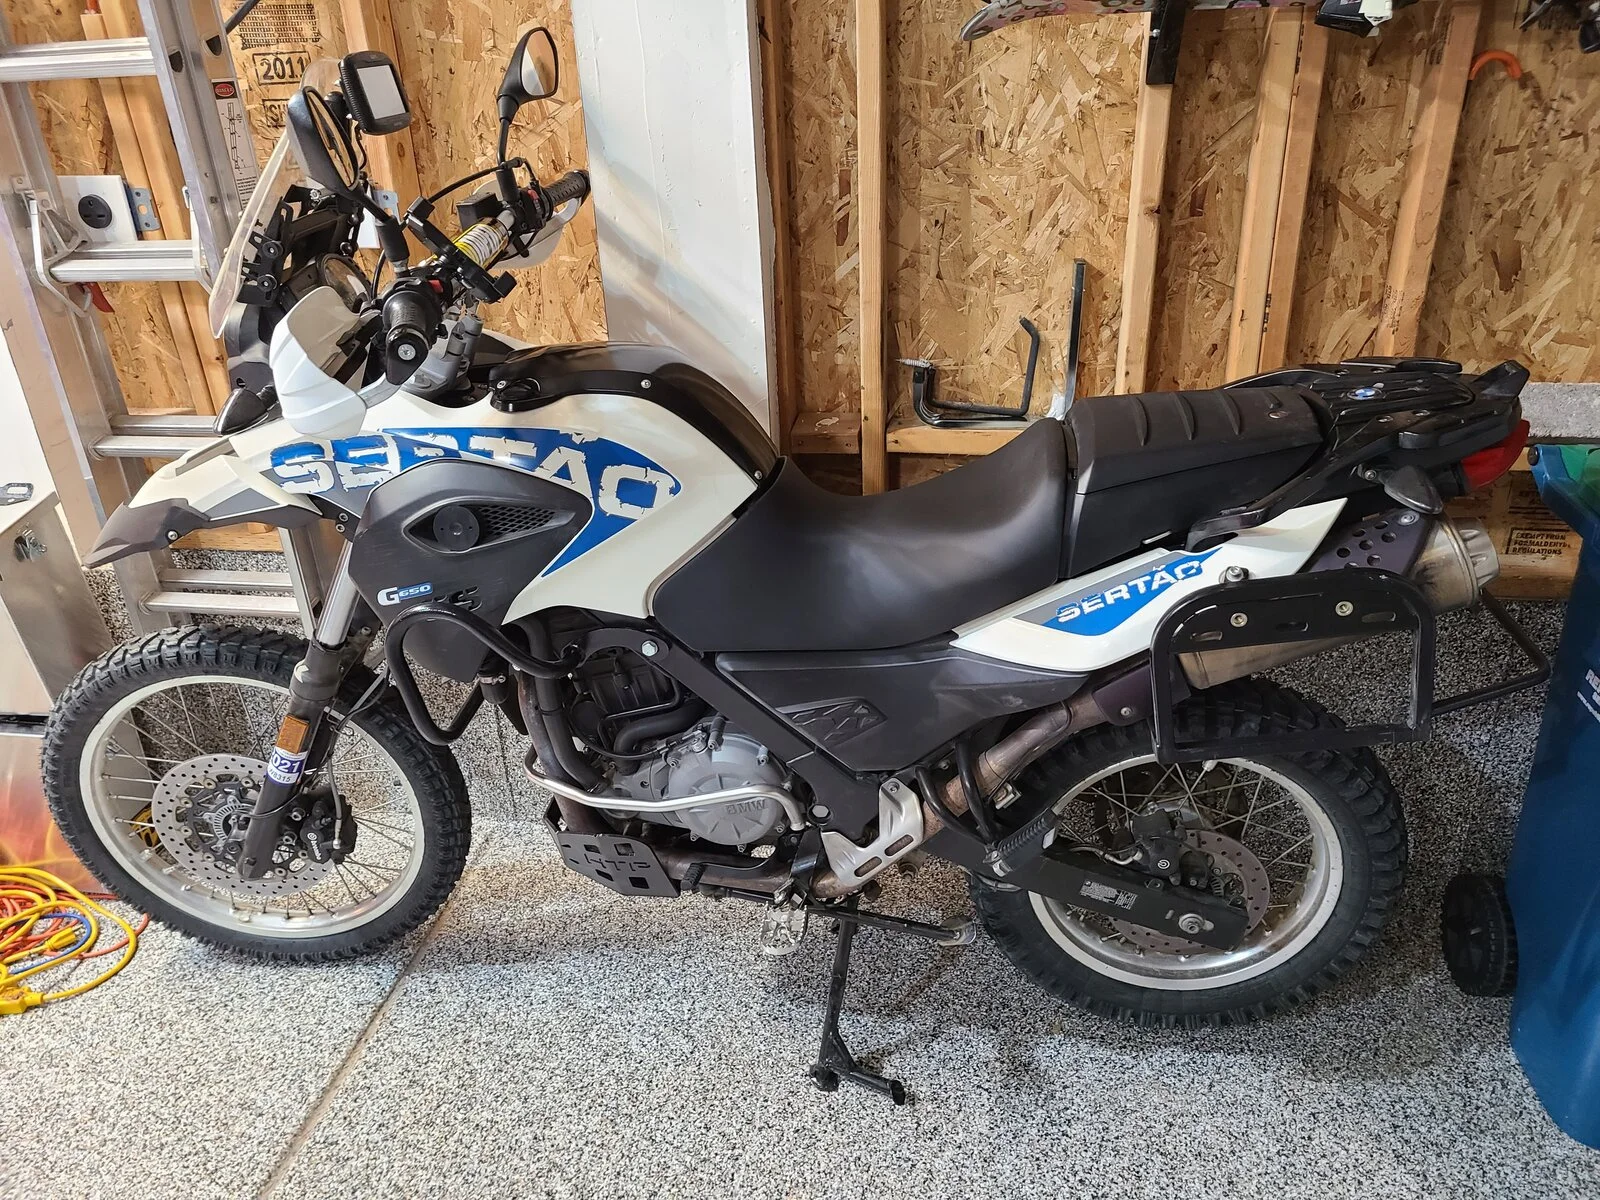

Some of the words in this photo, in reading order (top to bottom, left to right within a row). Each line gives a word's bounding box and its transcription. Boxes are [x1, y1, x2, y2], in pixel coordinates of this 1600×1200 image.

[260, 56, 305, 80] 2011
[1516, 532, 1544, 540] EXEMPT
[1512, 547, 1562, 555] REGULATIONS
[726, 798, 767, 815] BMW
